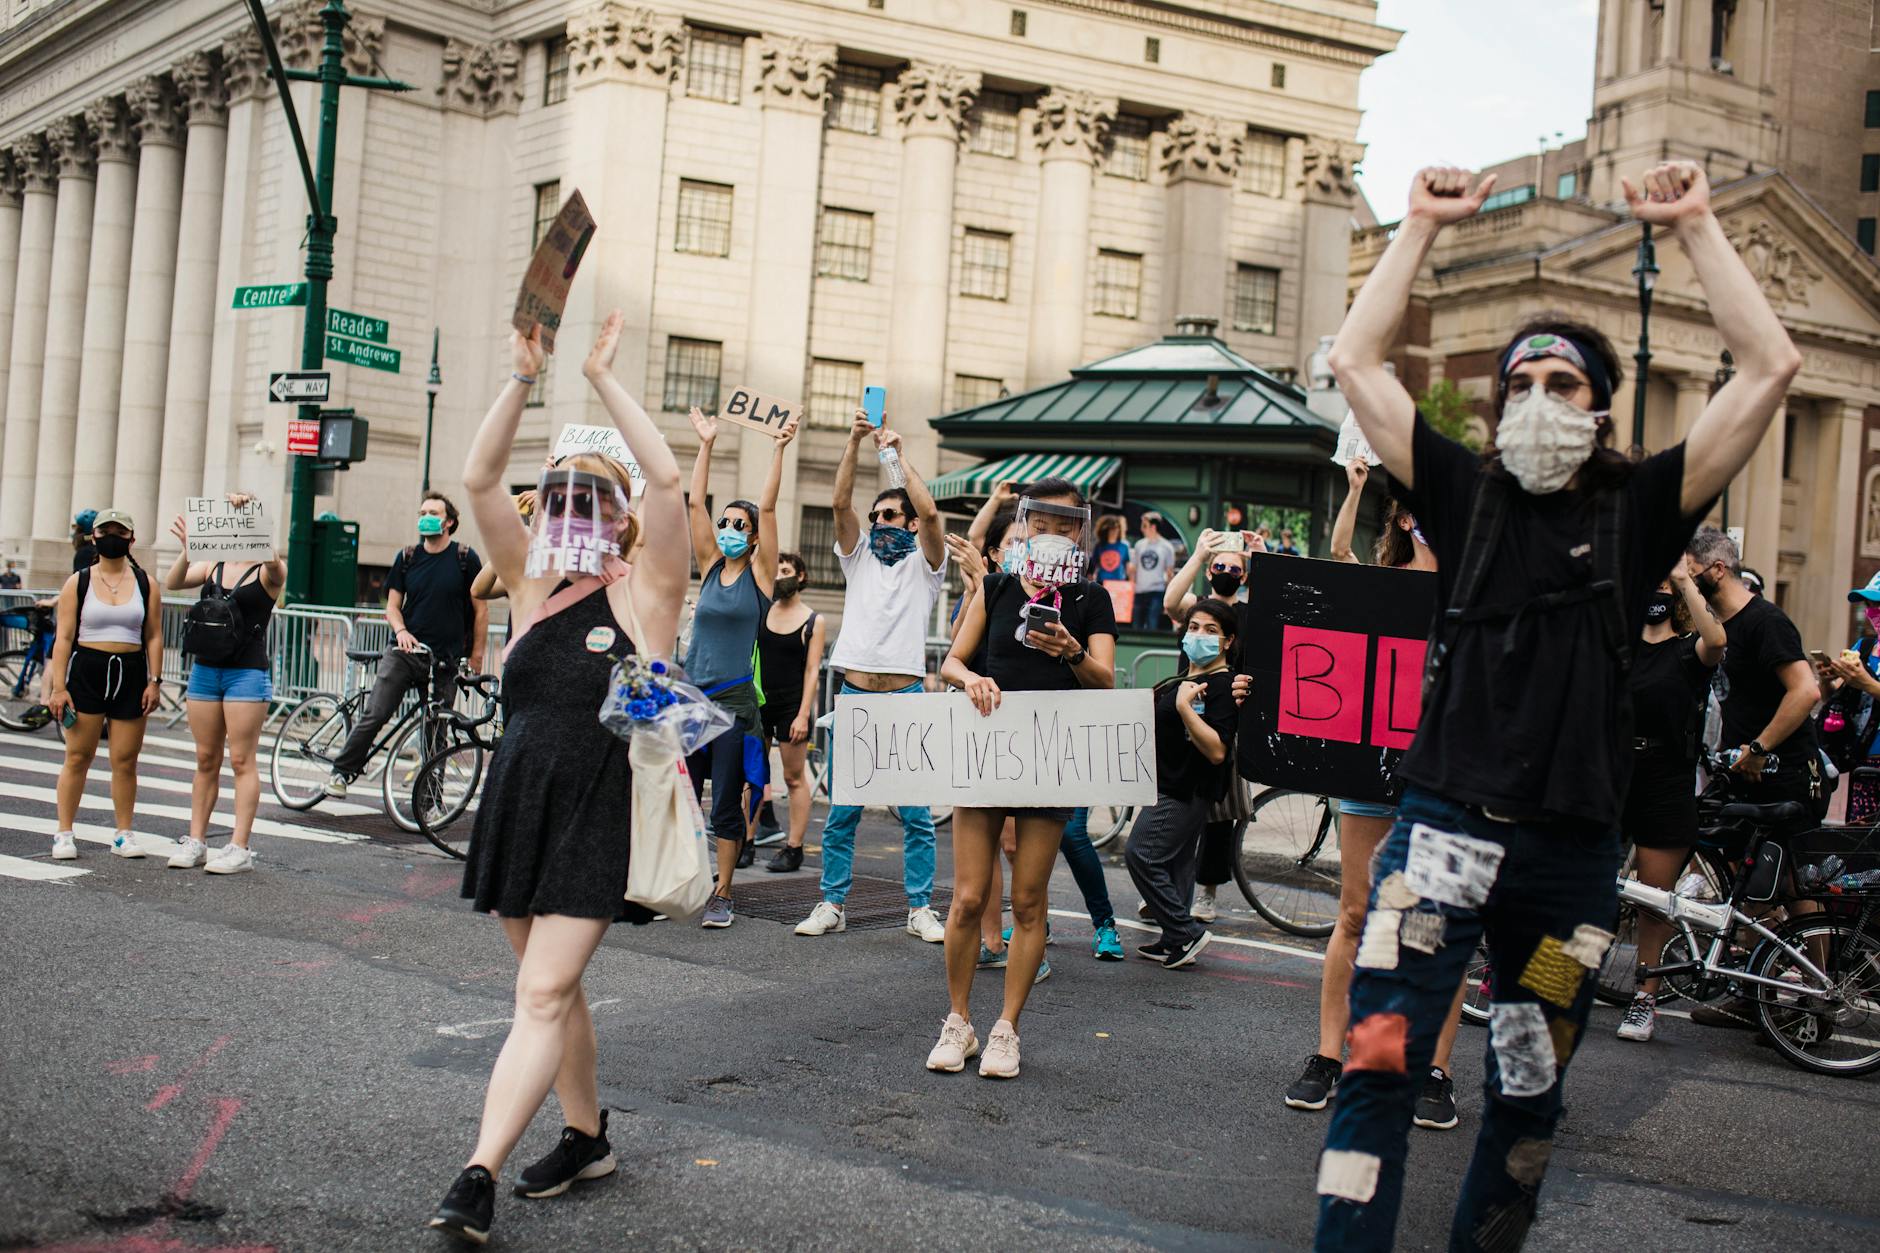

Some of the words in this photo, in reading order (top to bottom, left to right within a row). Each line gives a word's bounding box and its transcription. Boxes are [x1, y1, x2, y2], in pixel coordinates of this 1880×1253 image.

[242, 289, 287, 306] Centre
[331, 311, 373, 339] Reade
[375, 321, 384, 334] St
[330, 338, 344, 353] St.
[348, 342, 396, 364] Andrews
[277, 382, 295, 394] ONE
[305, 382, 325, 393] WAY
[727, 391, 790, 430] BLM
[562, 427, 614, 445] BLACK
[188, 498, 216, 513] LET
[197, 516, 256, 532] BREATHE
[189, 541, 218, 551] BLACK
[220, 542, 244, 551] LIVES
[246, 541, 271, 550] MATTER
[562, 533, 621, 557] LIVES
[1011, 540, 1027, 559] NO
[1030, 546, 1085, 568] JUSTICE
[1010, 558, 1028, 576] NO
[1032, 561, 1079, 584] PEACE
[1285, 643, 1418, 734] BL
[852, 707, 935, 789] BLACK
[949, 707, 1024, 789] LIVES
[1034, 709, 1154, 786] MATTER
